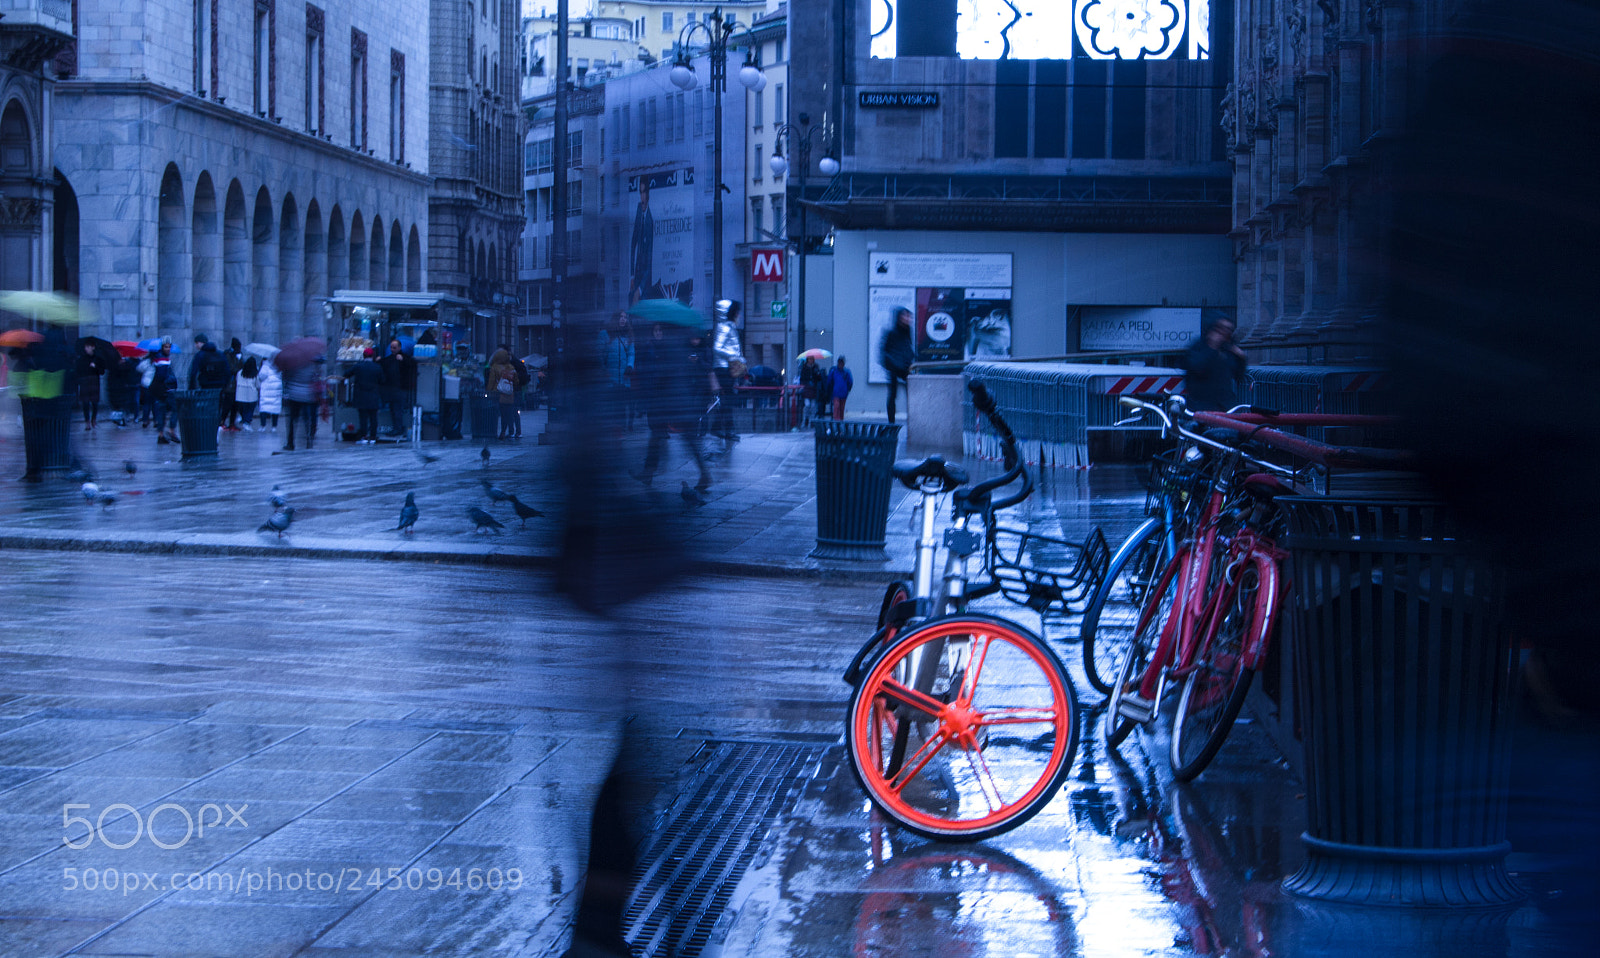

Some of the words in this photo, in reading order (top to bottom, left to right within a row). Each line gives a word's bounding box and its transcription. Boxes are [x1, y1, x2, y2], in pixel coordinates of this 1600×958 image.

[861, 94, 898, 105] URBAN
[900, 94, 937, 105] VISION
[753, 253, 782, 276] M
[1118, 320, 1126, 331] A
[1128, 320, 1153, 332] PIEDI
[1142, 331, 1161, 341] ON
[1163, 331, 1194, 342] FOOT
